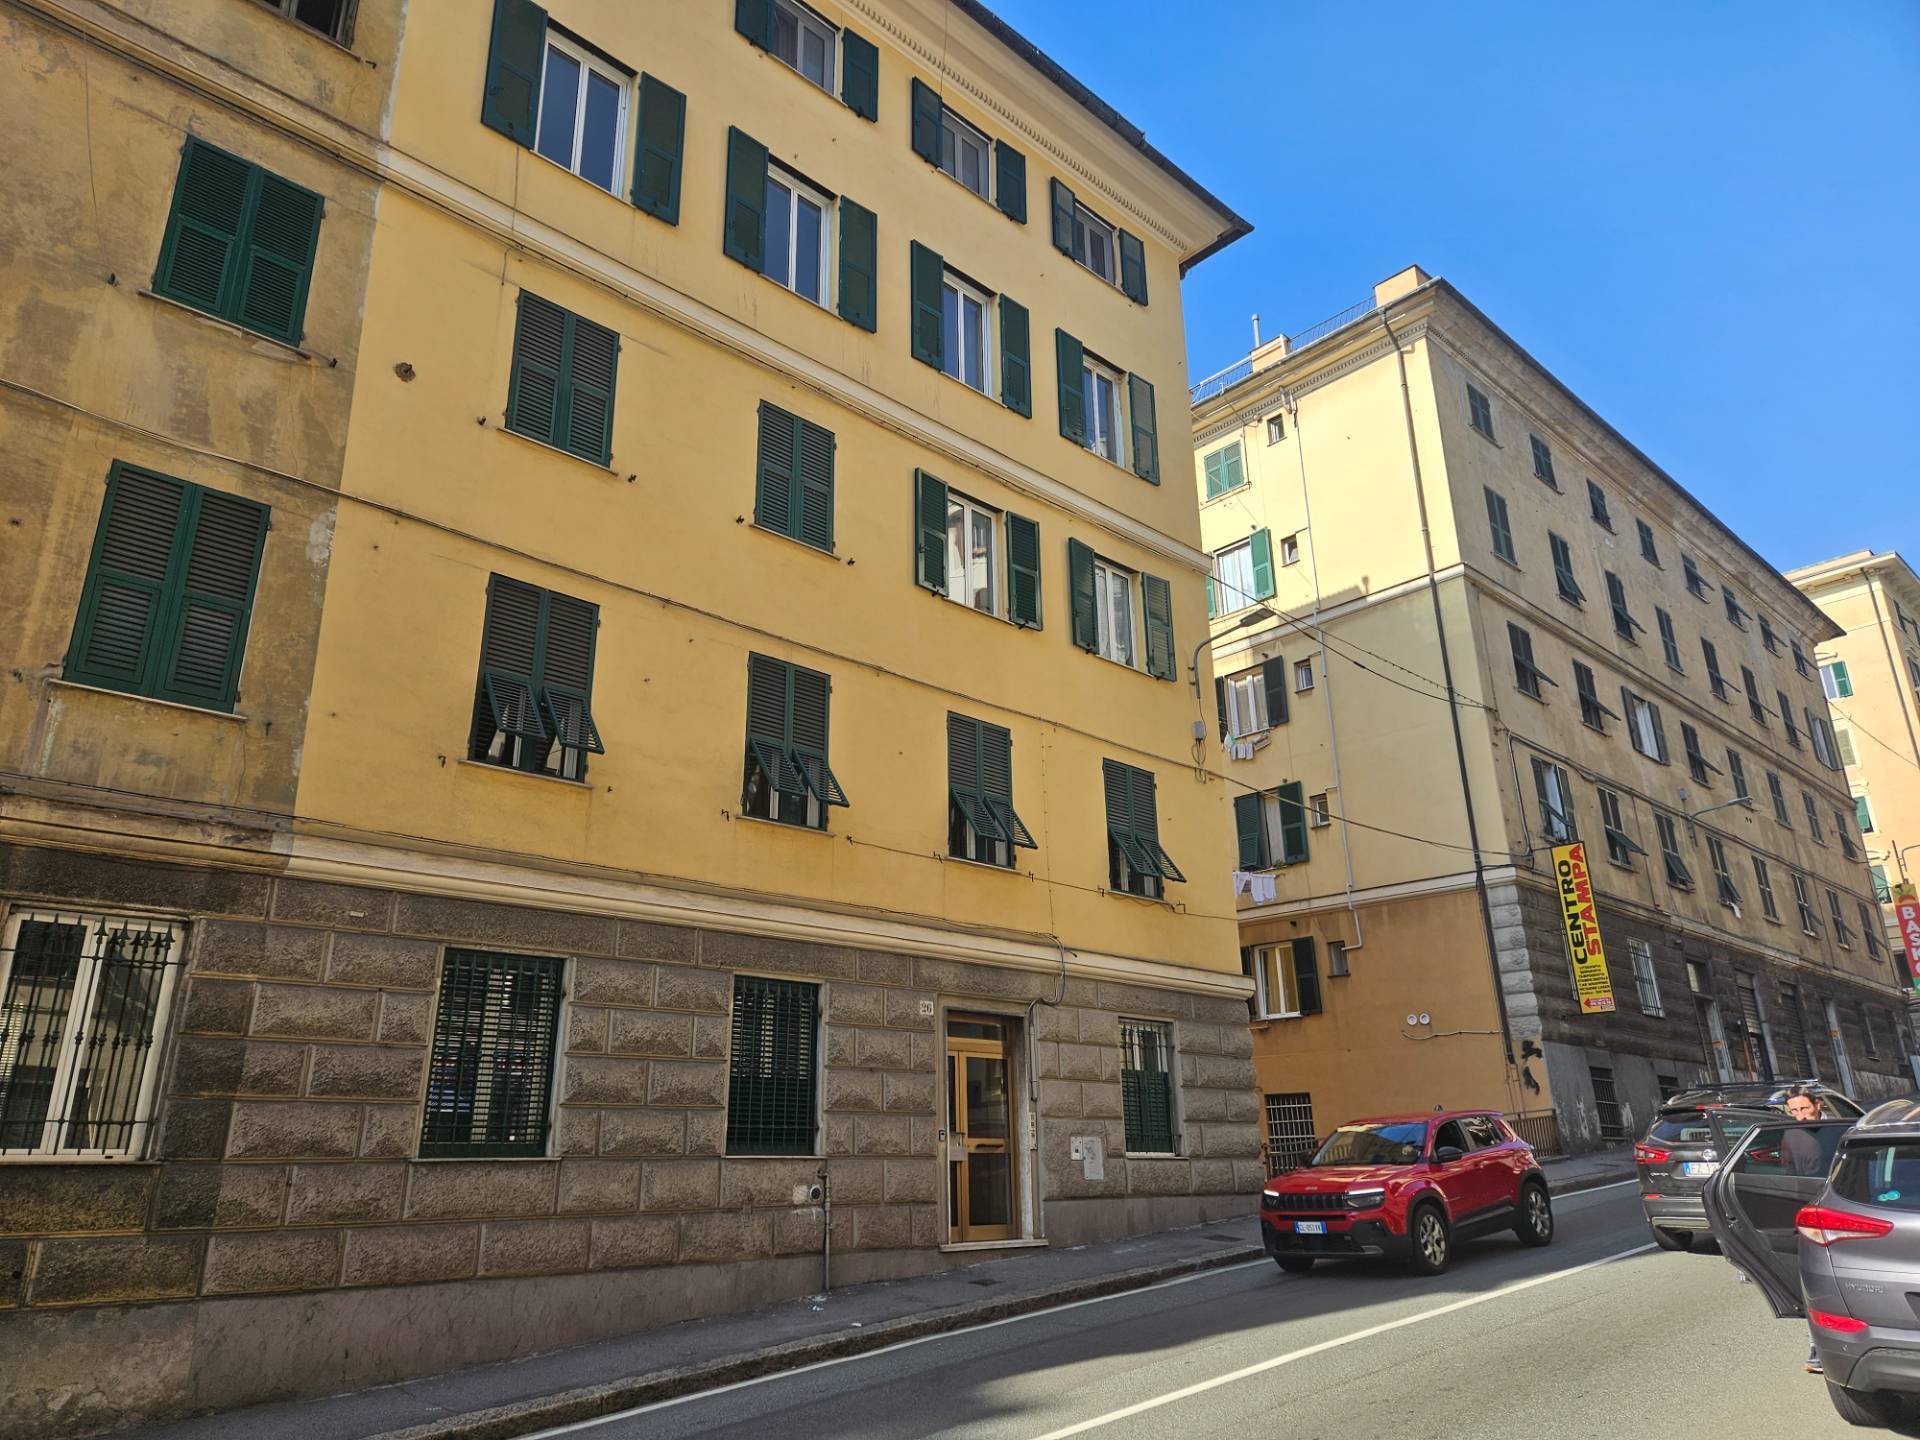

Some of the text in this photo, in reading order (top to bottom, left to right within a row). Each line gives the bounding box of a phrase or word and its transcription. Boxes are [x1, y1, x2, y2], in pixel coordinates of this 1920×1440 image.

[1557, 859, 1588, 965] CENTRO
[1569, 843, 1601, 956] STAMPA
[920, 1002, 932, 1014] 26
